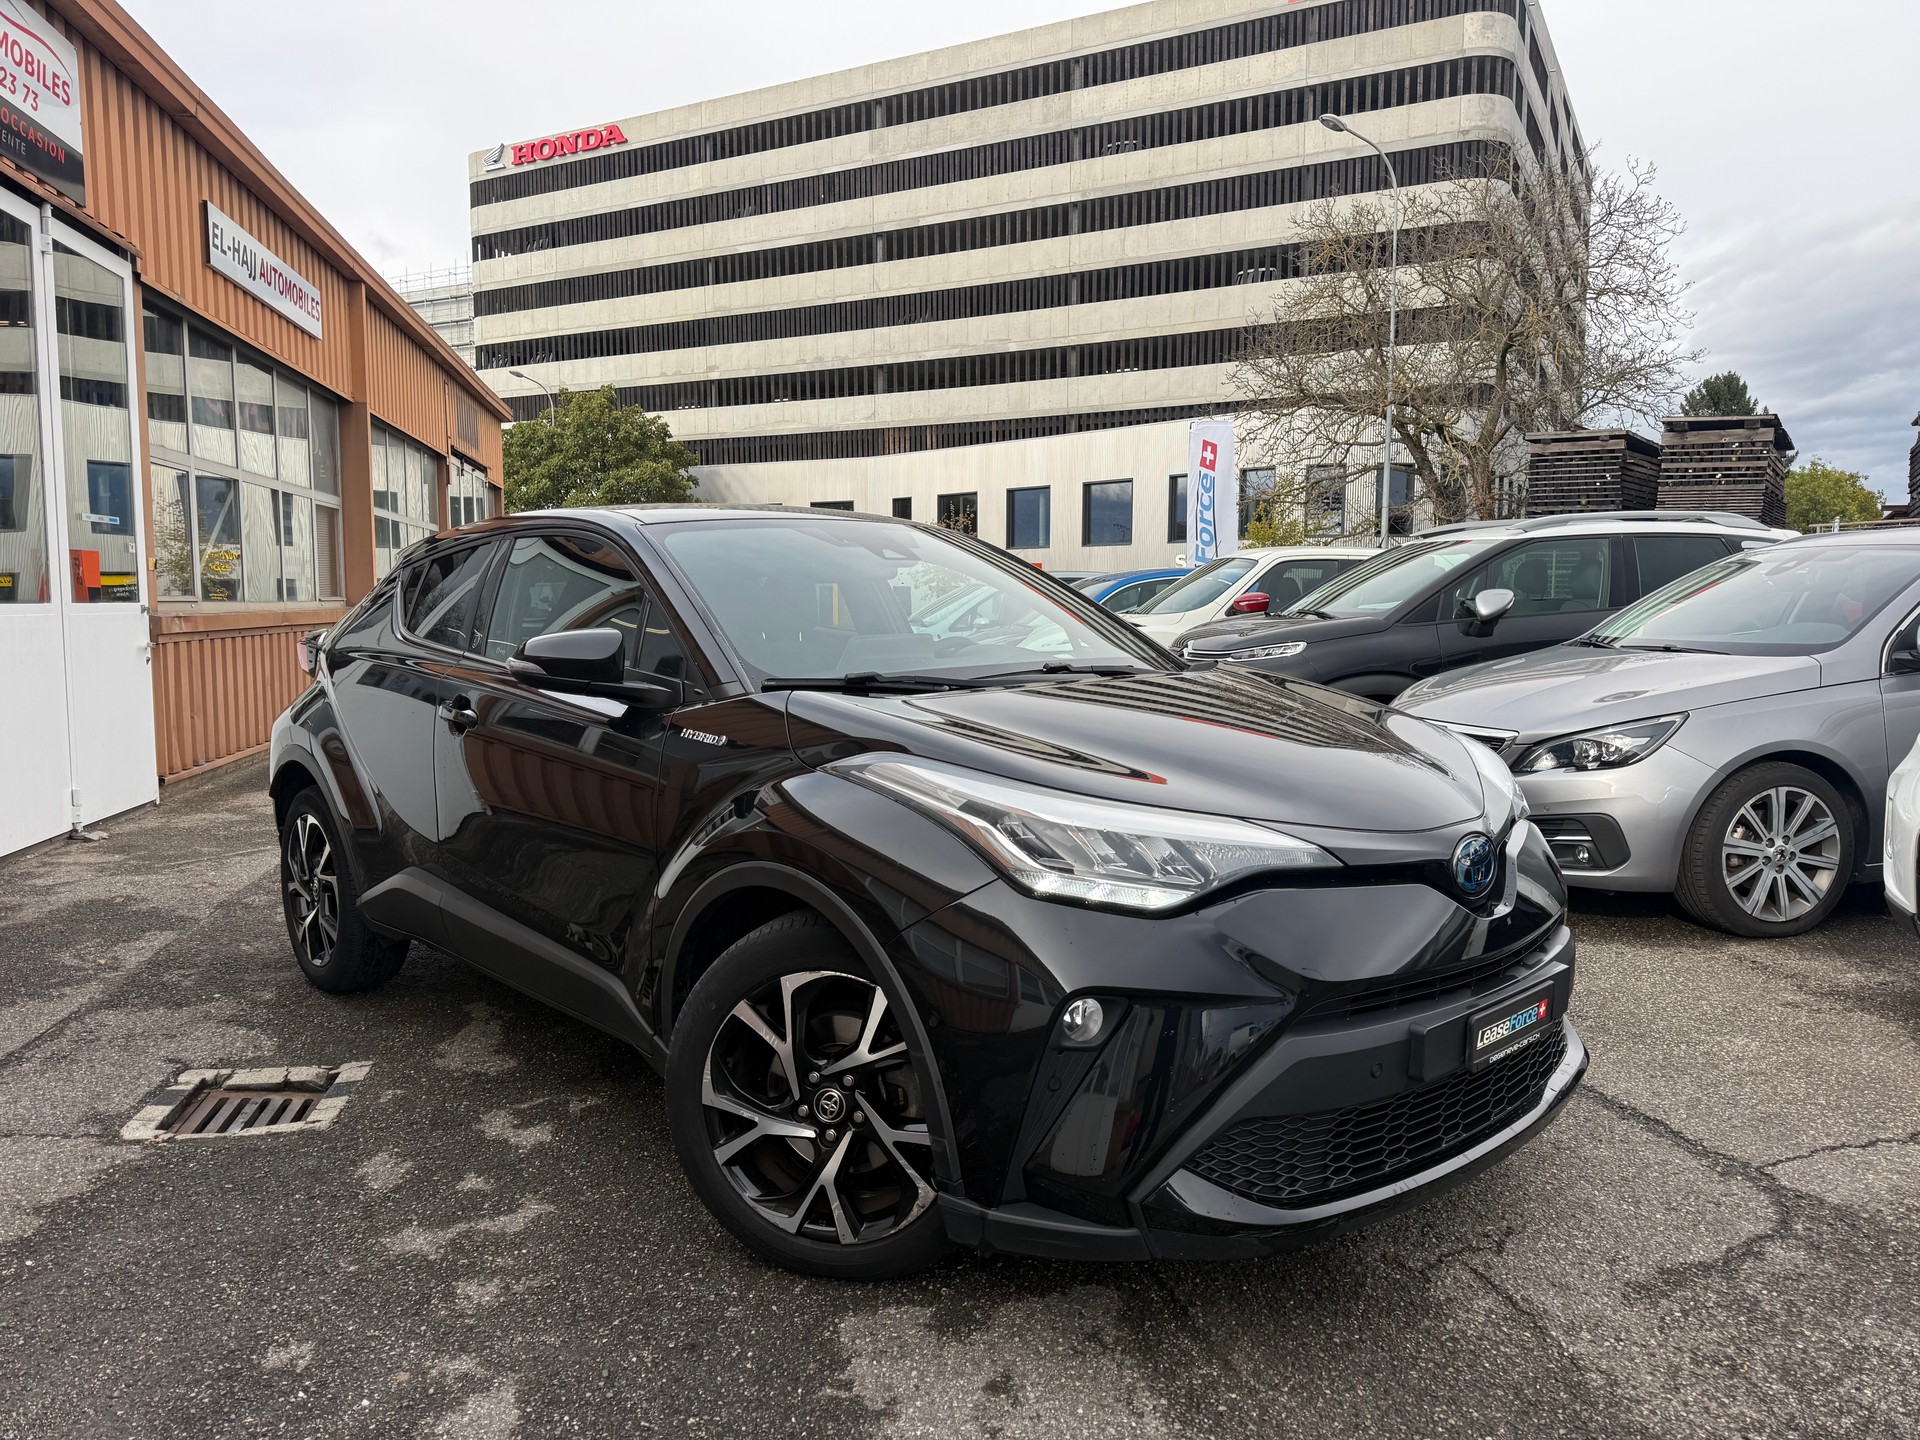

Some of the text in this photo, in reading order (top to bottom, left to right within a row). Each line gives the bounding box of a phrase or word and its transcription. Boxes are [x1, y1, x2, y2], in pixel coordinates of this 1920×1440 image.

[22, 83, 39, 112] 73
[0, 126, 27, 155] ENTE
[511, 124, 628, 165] HONDA
[211, 221, 321, 322] EL-HAJJ AUTOMOBILES
[680, 728, 719, 746] HYBRID
[1477, 1005, 1538, 1048] LeaseForce
